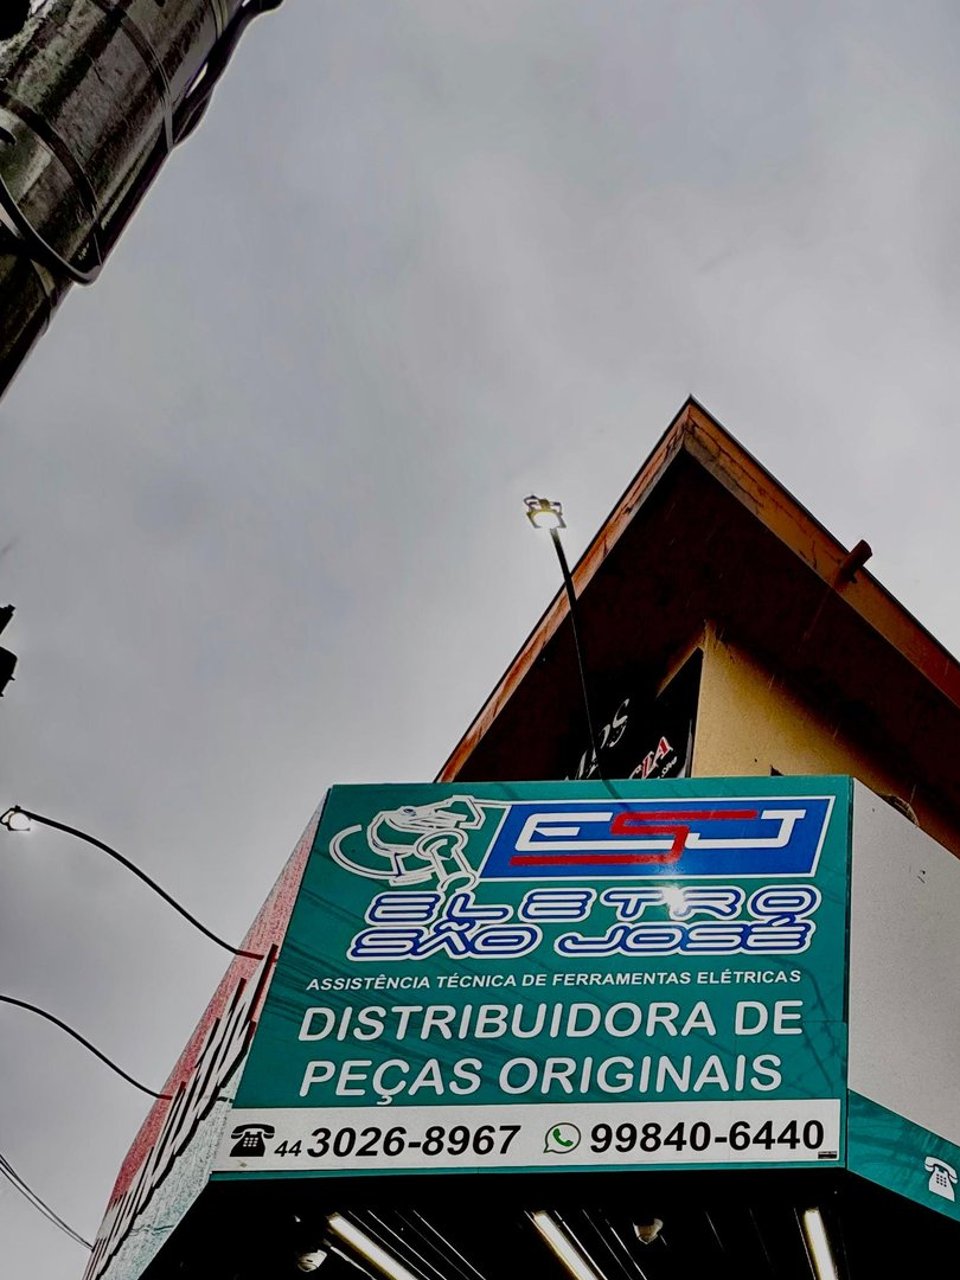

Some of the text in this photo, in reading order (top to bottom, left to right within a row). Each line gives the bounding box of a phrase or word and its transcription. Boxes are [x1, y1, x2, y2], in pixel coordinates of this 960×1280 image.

[509, 810, 806, 866] ESJ
[365, 884, 822, 926] ELETRO
[347, 913, 816, 962] SÃO JOSÉ
[306, 968, 801, 991] ASSISTÊNCIA TÉCNICA DE FERRAMENTAS ELÉTRICAS
[298, 1000, 804, 1042] DISTRIBUIDORA DE
[299, 1054, 783, 1106] PEÇAS ORIGINAIS
[274, 1125, 521, 1158] 44 3026-8967
[590, 1120, 824, 1152] 99840-6440
